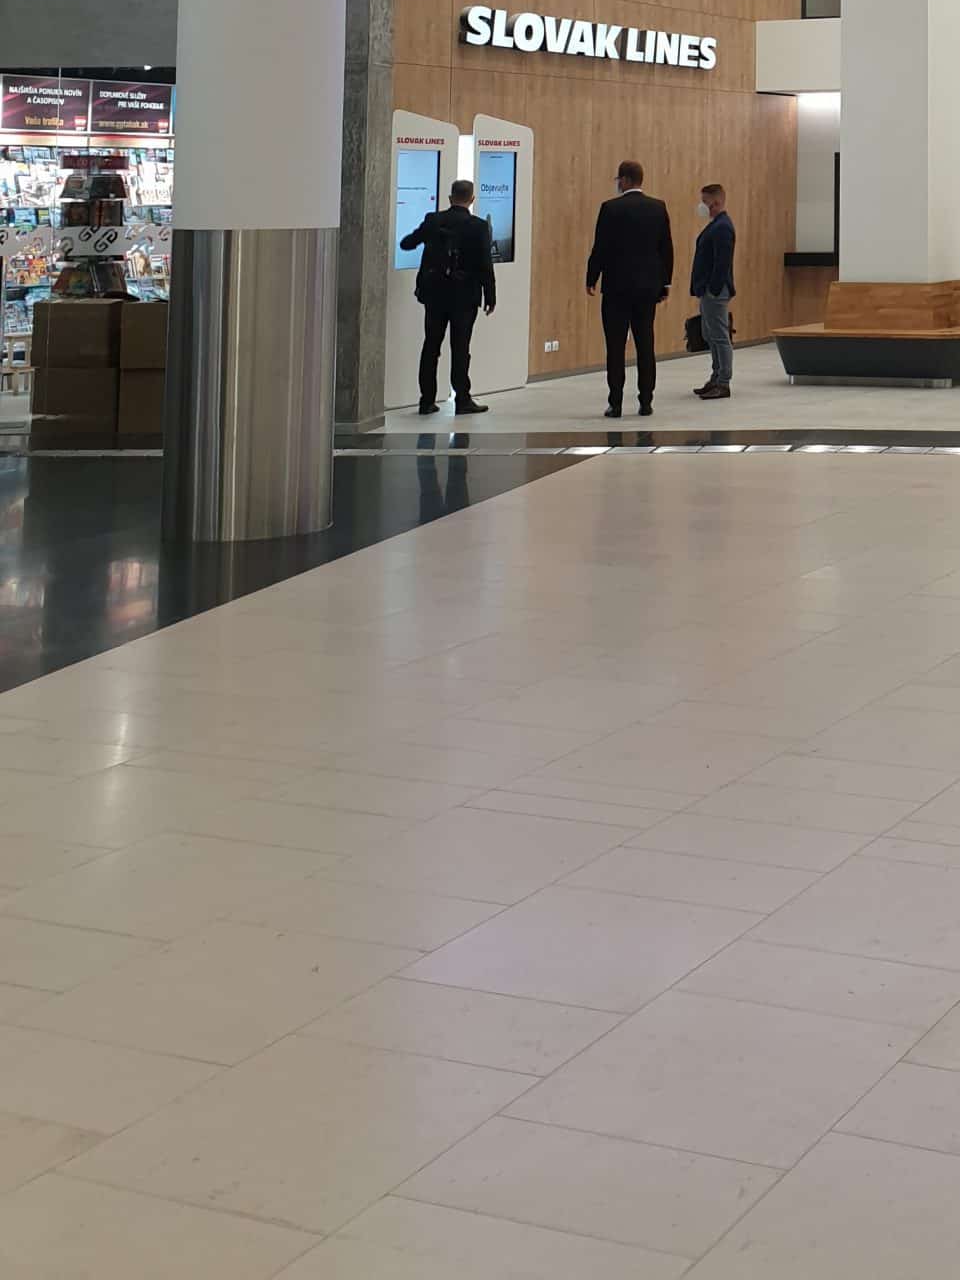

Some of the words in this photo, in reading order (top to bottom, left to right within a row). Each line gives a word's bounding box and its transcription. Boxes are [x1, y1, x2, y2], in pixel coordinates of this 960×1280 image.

[465, 5, 622, 60] SLOVAK
[626, 27, 717, 70] LINES
[397, 137, 424, 145] SLOVAK
